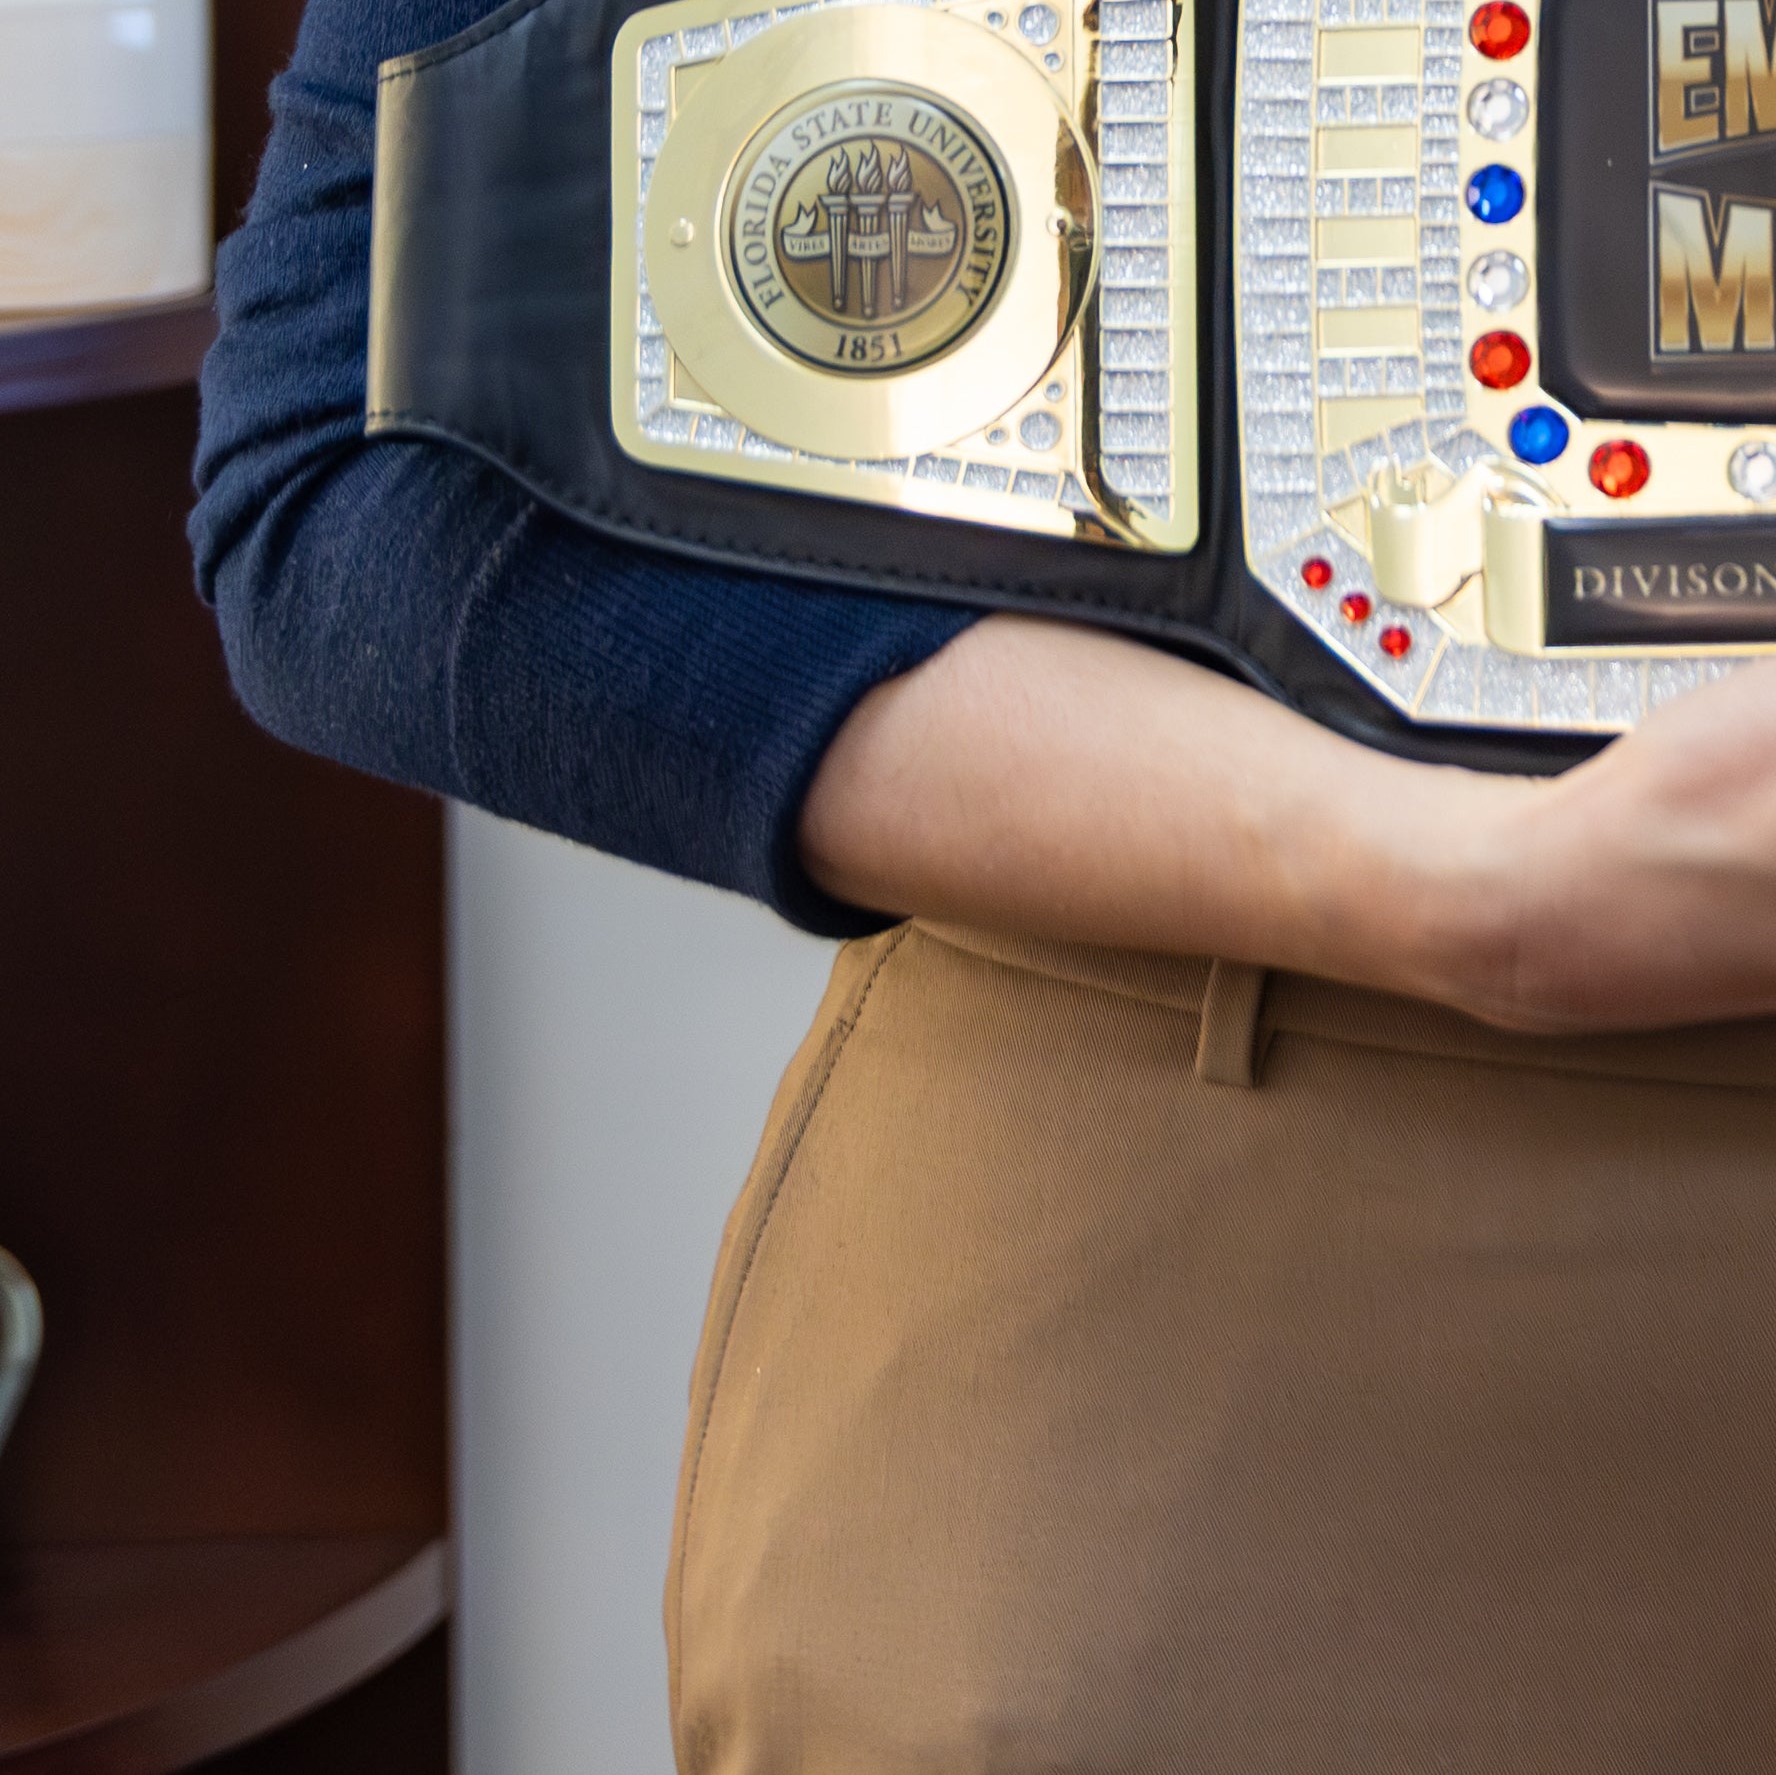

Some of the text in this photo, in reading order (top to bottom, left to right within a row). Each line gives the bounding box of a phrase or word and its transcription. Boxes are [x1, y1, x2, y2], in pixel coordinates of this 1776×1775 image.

[742, 100, 998, 310] FLORIDA STATE UNIVERSITY
[833, 333, 903, 363] 1851
